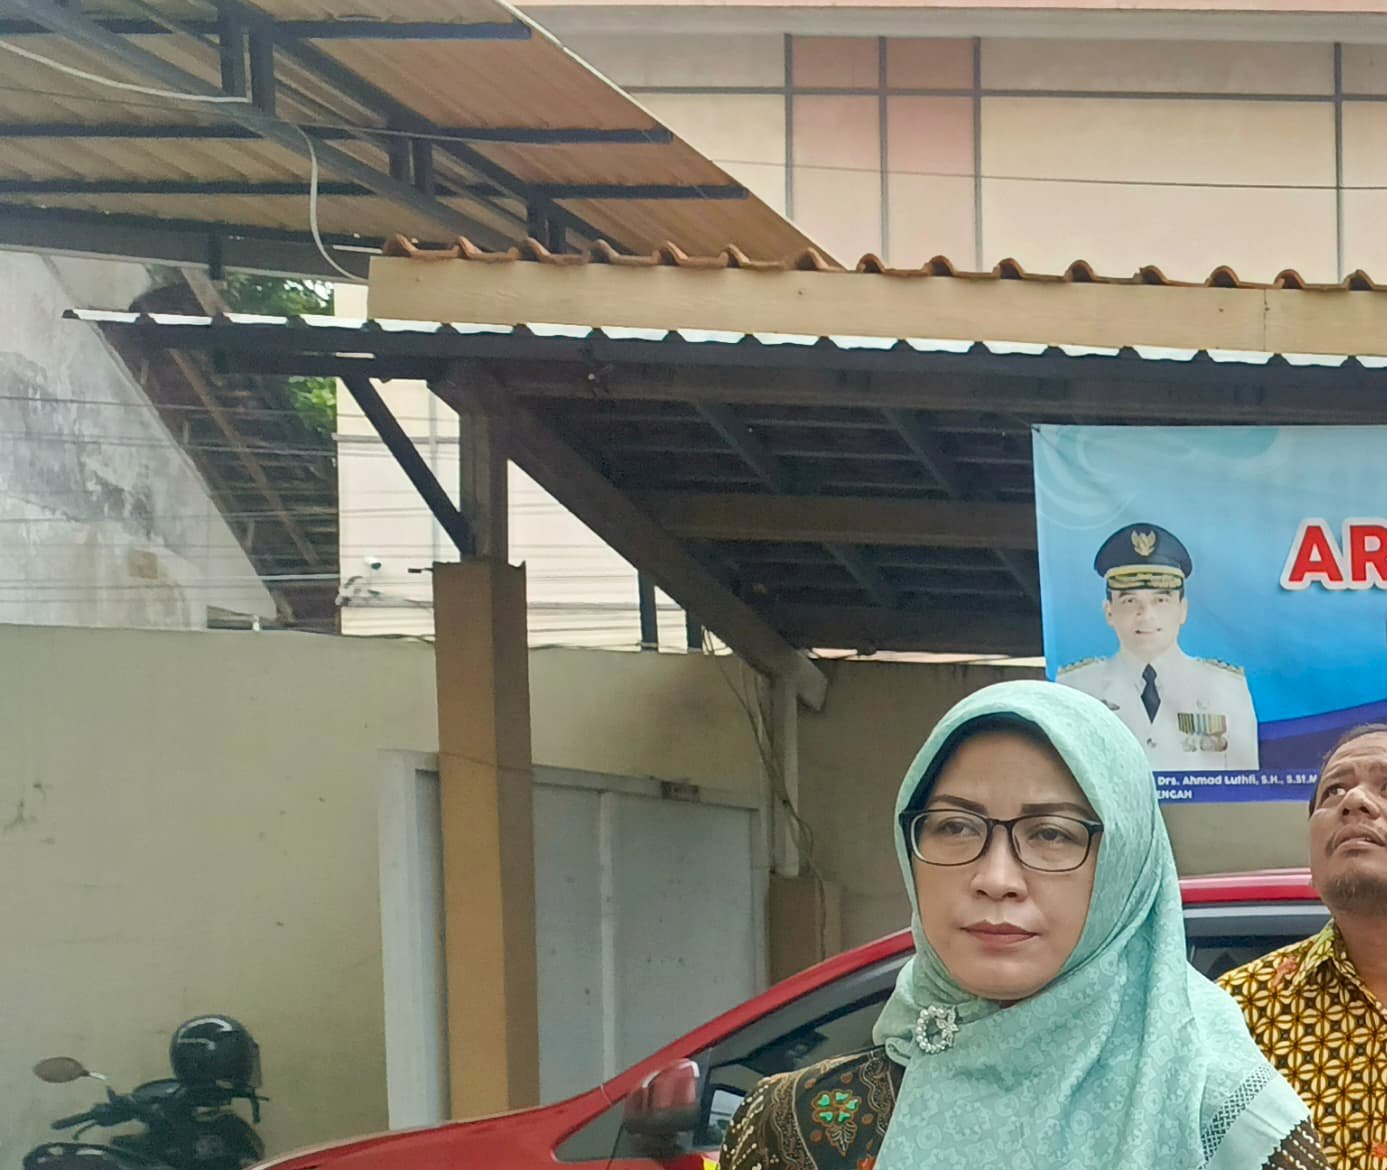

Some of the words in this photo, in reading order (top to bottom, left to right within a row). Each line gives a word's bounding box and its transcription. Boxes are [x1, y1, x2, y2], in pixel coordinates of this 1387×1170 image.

[1157, 775, 1180, 786] Drs.
[1182, 775, 1222, 785] Ahmad
[1224, 774, 1259, 786] Luthfi,
